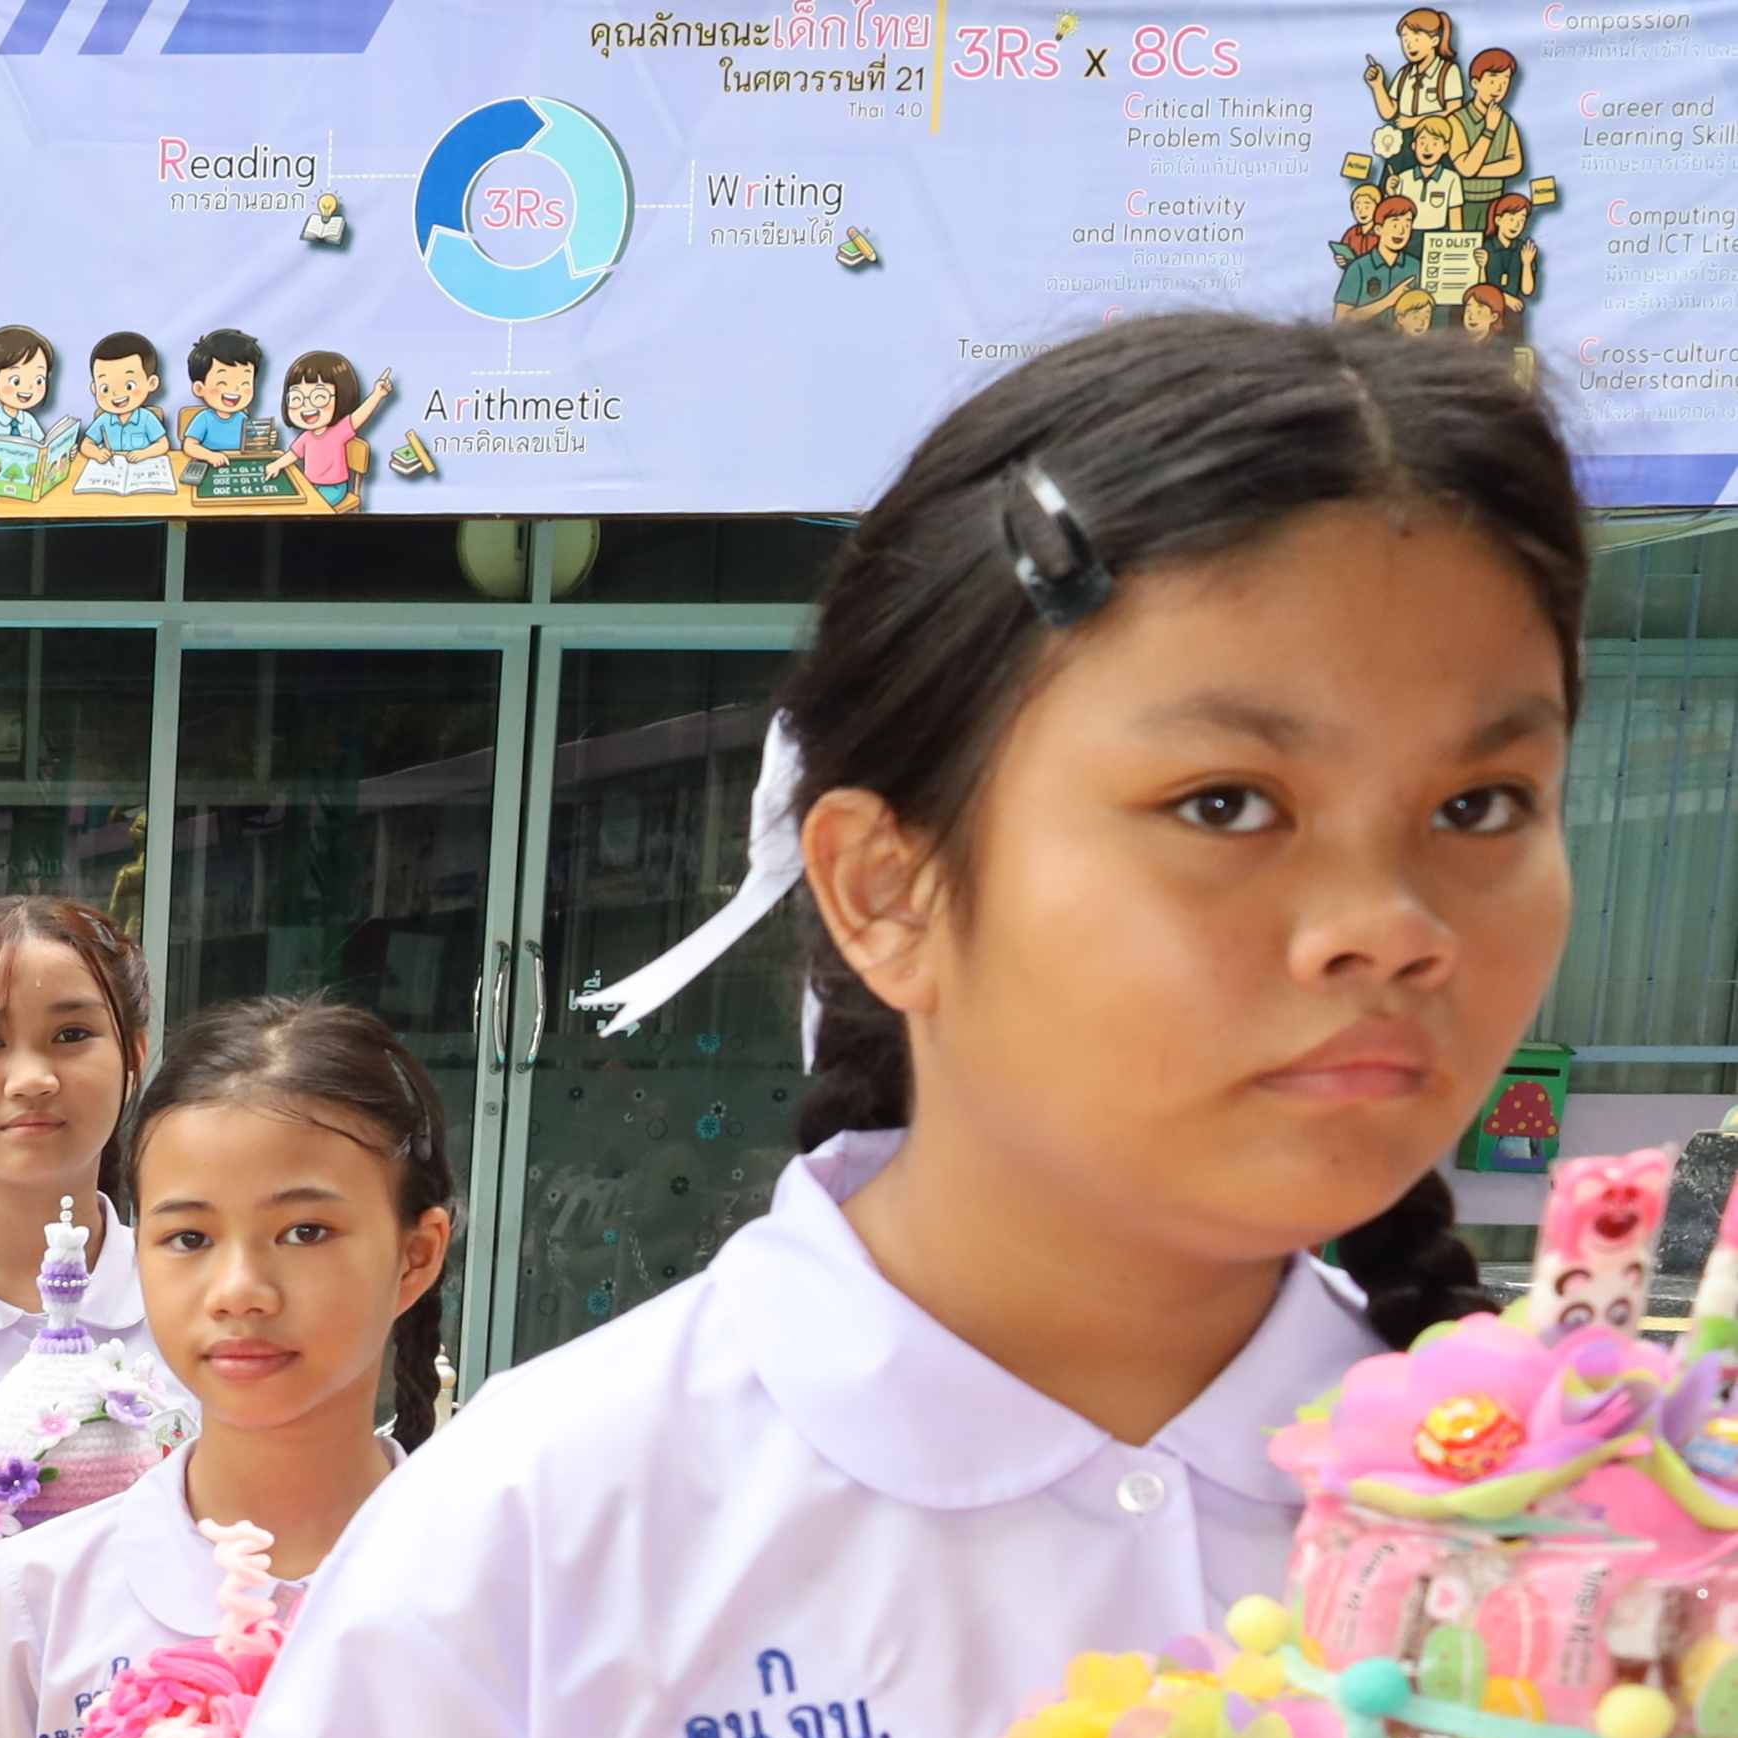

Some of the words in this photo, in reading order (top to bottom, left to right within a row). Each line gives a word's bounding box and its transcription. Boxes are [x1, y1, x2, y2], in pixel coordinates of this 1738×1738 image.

[1543, 4, 1692, 34] Compassion
[953, 26, 1061, 79] 3Rs
[1130, 25, 1242, 78] 8Cs
[896, 67, 926, 92] 21
[1125, 93, 1210, 120] Critical
[1219, 97, 1314, 124] Thinking
[1580, 92, 1664, 118] Career
[1672, 96, 1715, 117] and
[1127, 127, 1221, 149] Problem
[1229, 127, 1313, 153] Solving
[1583, 126, 1683, 151] Learning
[159, 137, 318, 188] Reading
[482, 187, 567, 229] 3Rs
[708, 175, 844, 215] Writing
[1127, 190, 1246, 220] Creativity
[1608, 200, 1736, 230] Computing
[1072, 224, 1115, 243] and
[1124, 223, 1245, 244] Innovation
[1608, 233, 1650, 254] and
[1658, 233, 1694, 253] ICT
[756, 1646, 797, 1697] ก
